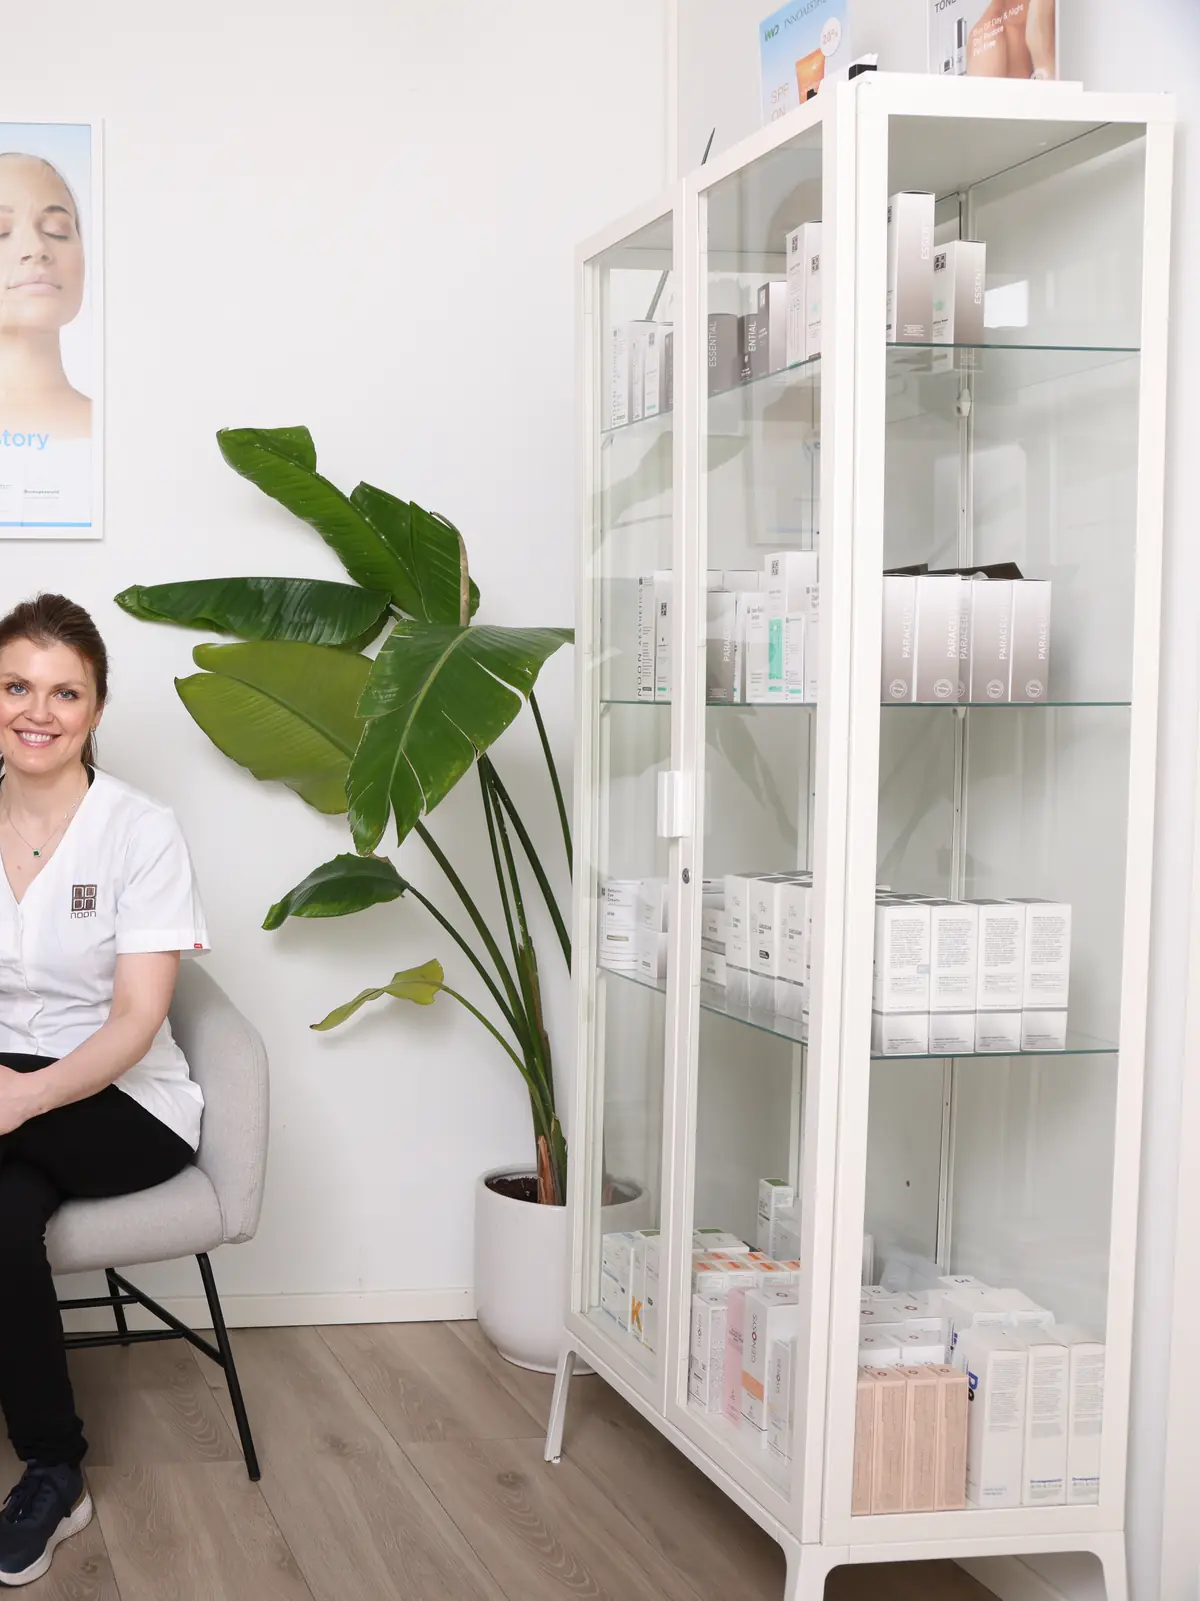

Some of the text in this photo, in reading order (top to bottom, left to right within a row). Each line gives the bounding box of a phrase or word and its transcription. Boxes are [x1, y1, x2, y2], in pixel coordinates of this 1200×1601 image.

[708, 321, 717, 367] ESSENTIAL
[748, 321, 757, 352] ENTIAL
[70, 910, 96, 919] noon
[750, 1313, 758, 1364] GENOSYS
